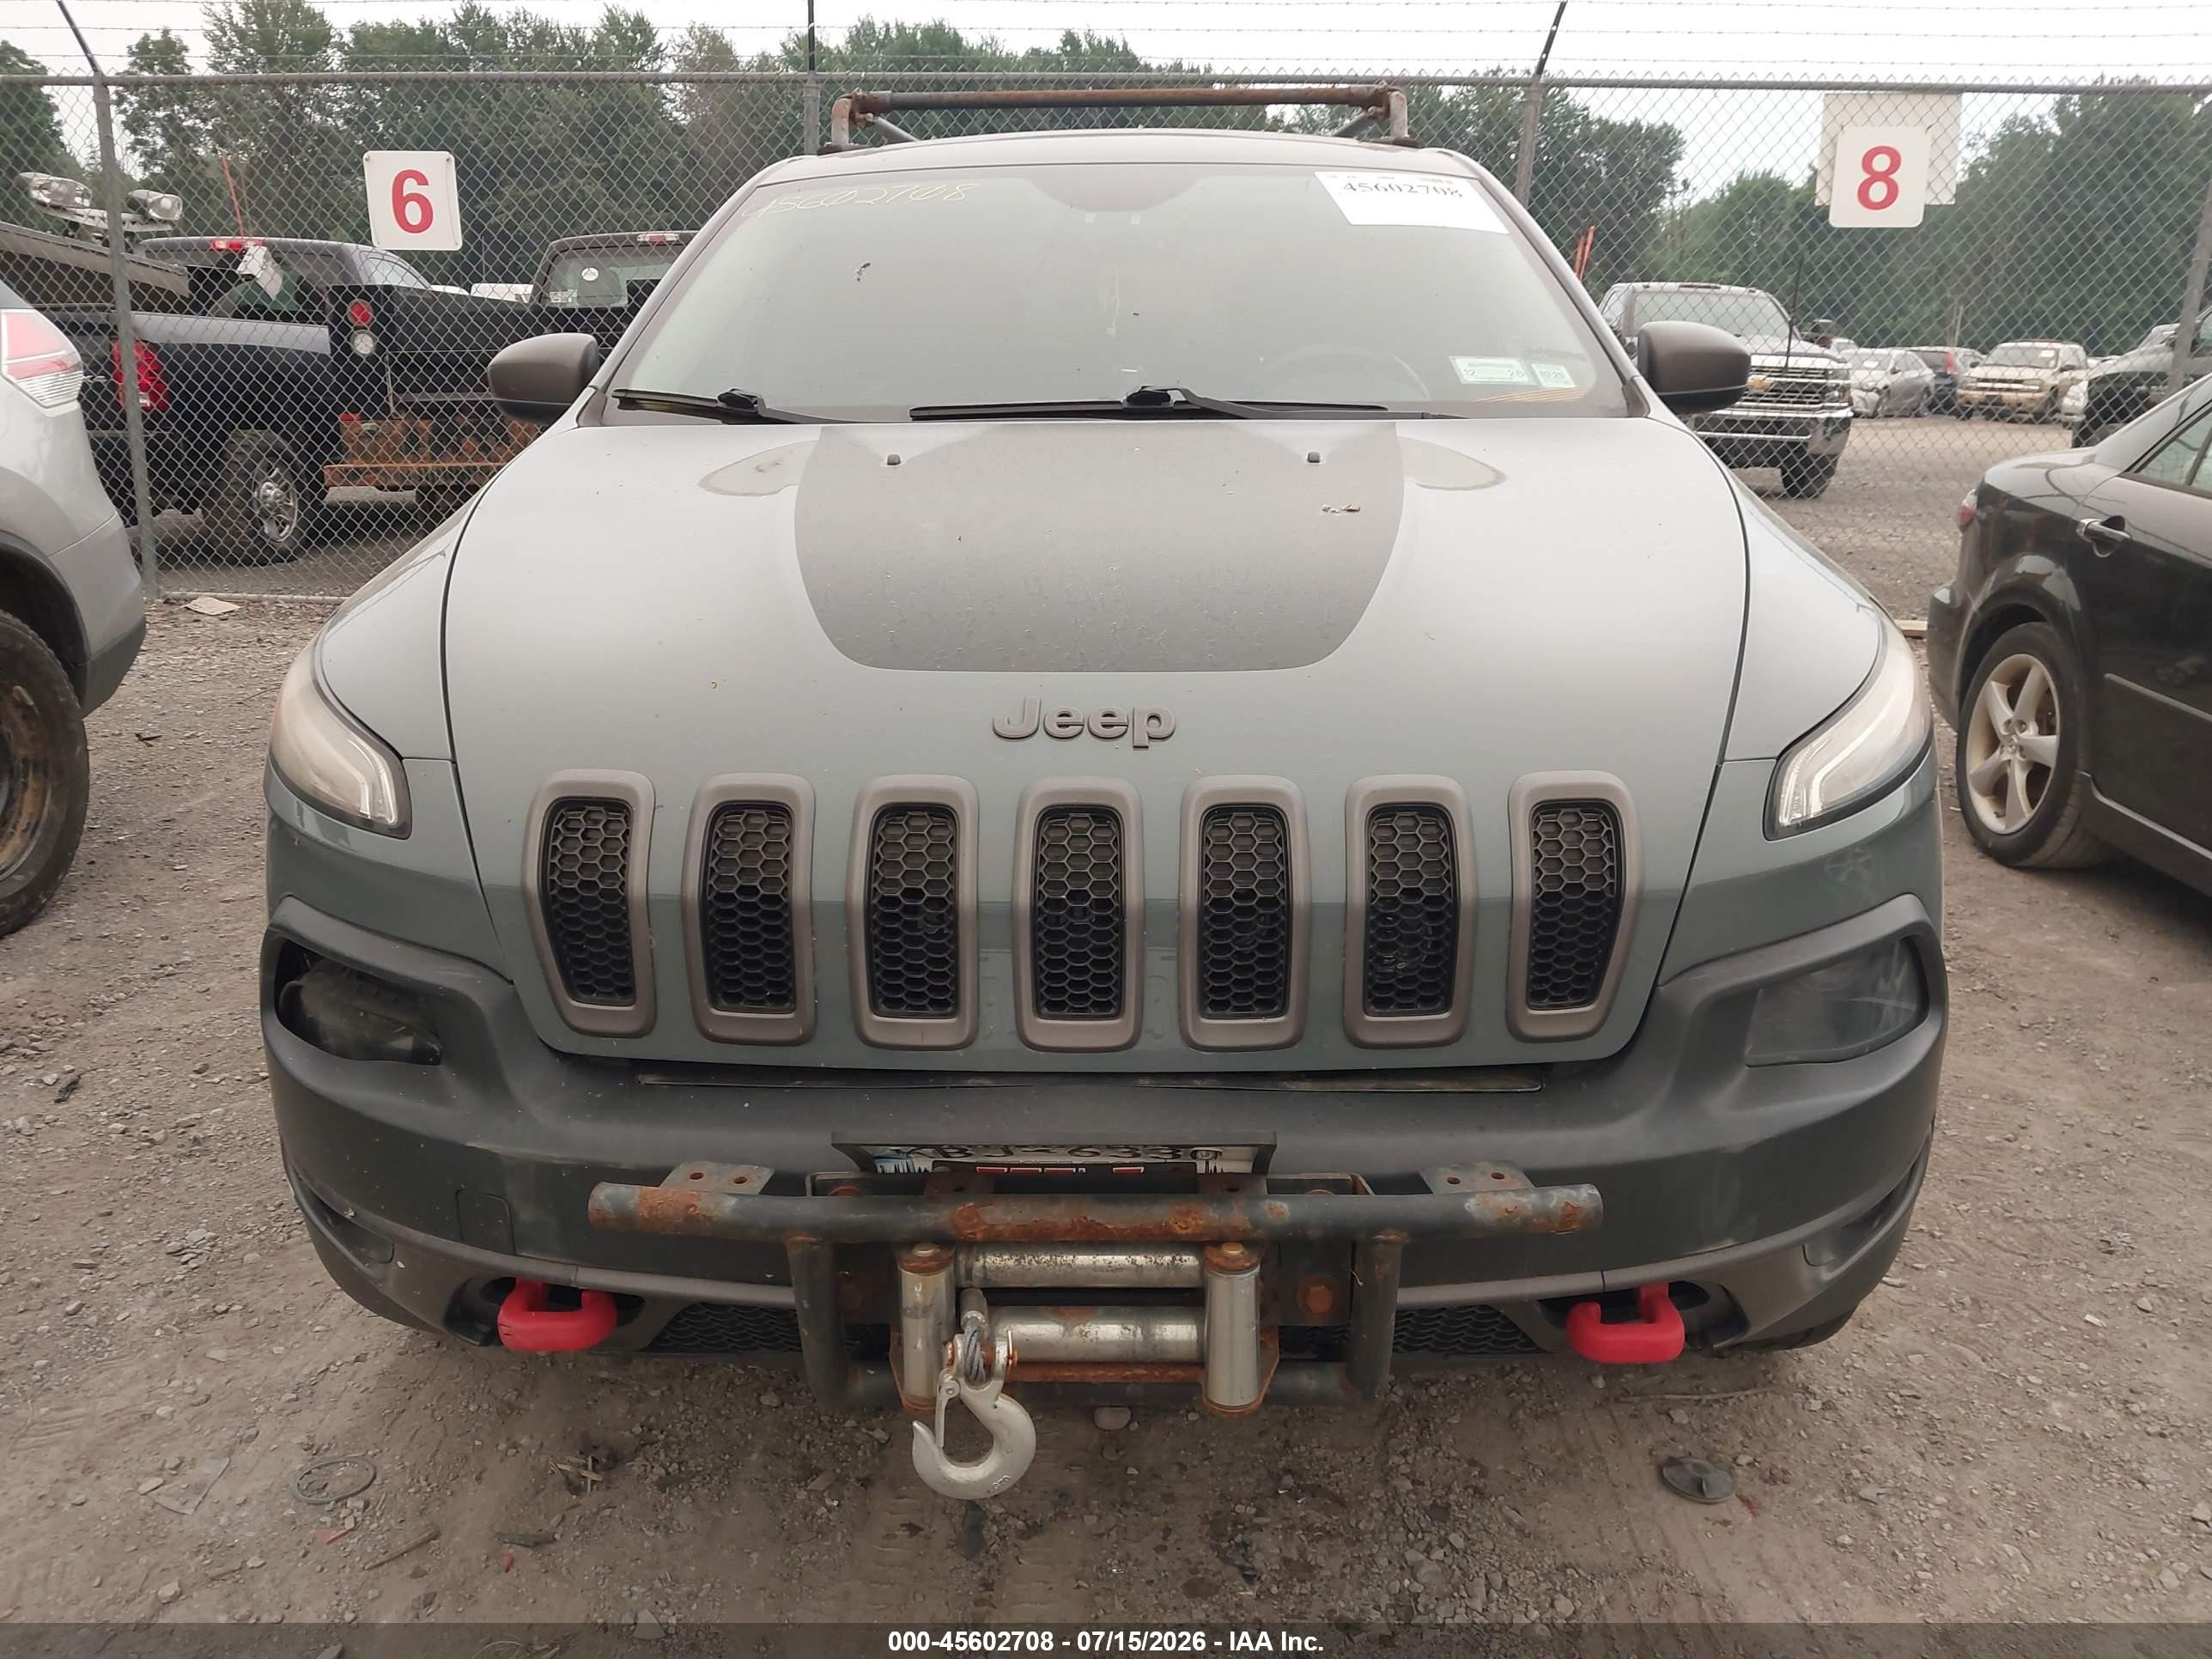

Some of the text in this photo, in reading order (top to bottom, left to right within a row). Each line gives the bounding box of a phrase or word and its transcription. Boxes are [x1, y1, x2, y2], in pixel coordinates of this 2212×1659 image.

[392, 169, 434, 234] 6
[1343, 182, 1463, 197] 45602708
[1857, 145, 1902, 210] 8
[992, 696, 1176, 750] Jeep
